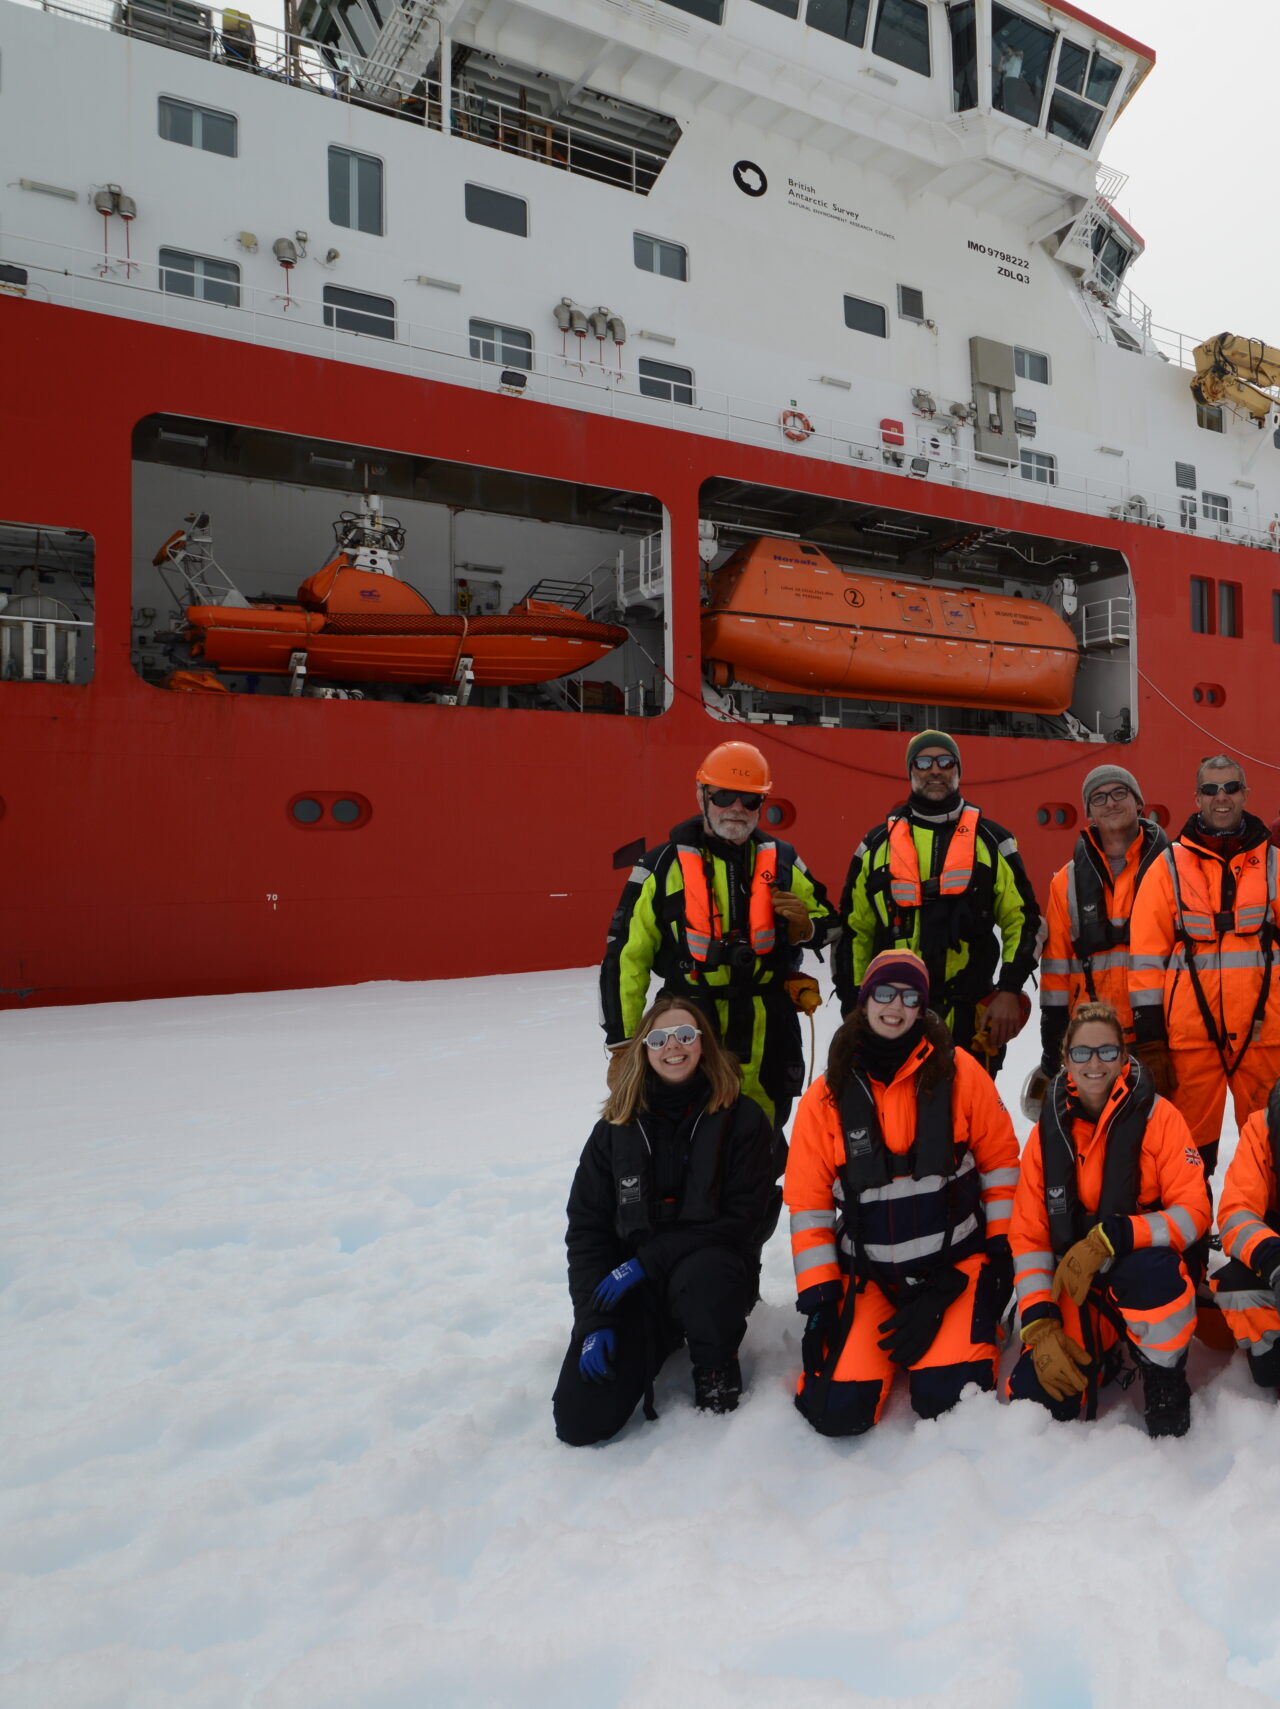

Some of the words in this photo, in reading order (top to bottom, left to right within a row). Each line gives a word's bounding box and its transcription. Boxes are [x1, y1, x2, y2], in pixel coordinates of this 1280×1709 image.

[788, 178, 816, 194] British
[788, 188, 828, 208] Antarctic
[832, 203, 860, 220] Survey
[788, 200, 811, 211] NATURAL
[849, 221, 873, 232] RESEARCH
[968, 240, 986, 254] IMO
[987, 247, 1029, 269] 9798222
[997, 266, 1030, 284] ZDLQ3
[266, 893, 278, 902] 70
